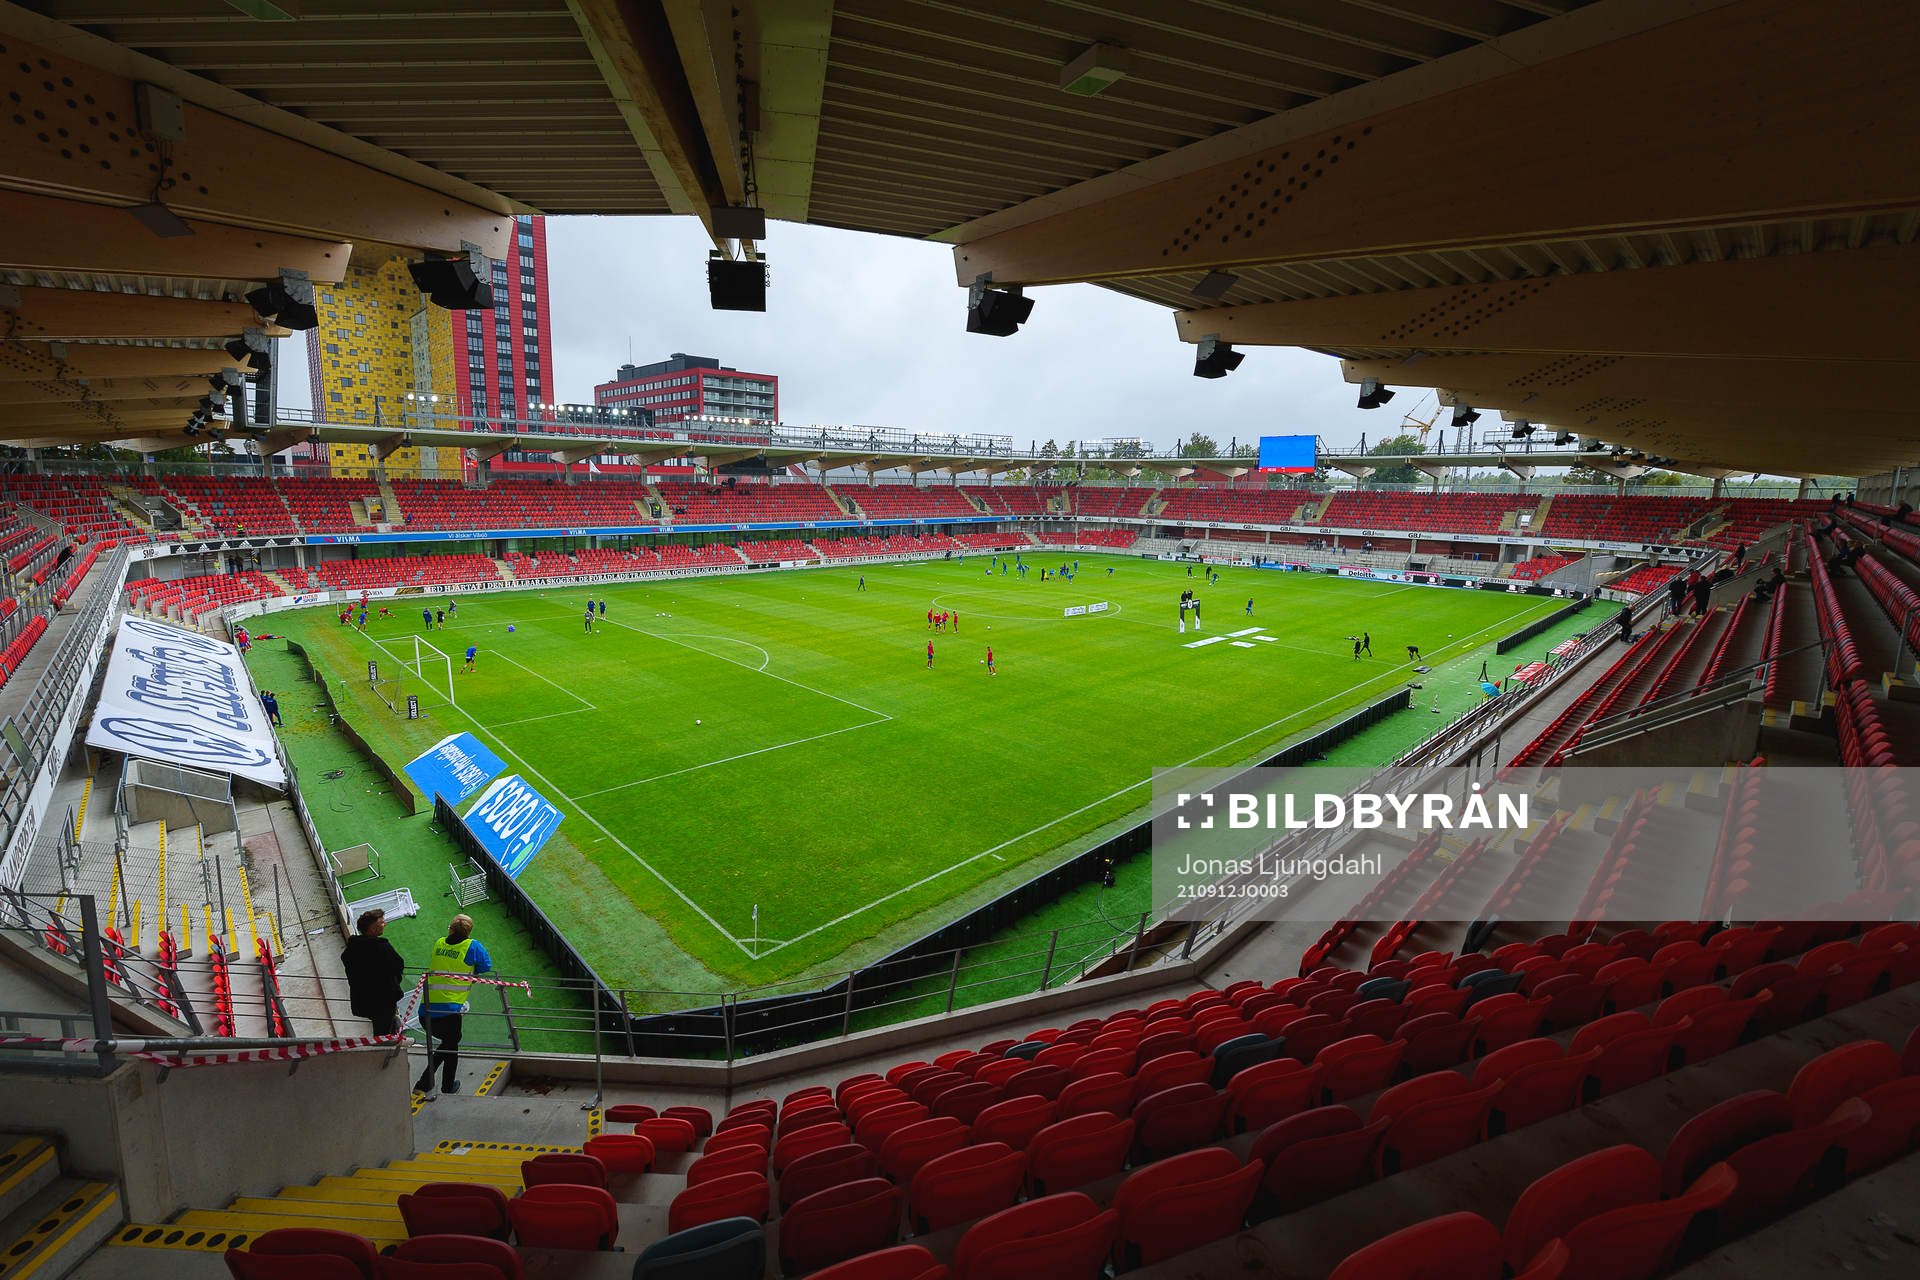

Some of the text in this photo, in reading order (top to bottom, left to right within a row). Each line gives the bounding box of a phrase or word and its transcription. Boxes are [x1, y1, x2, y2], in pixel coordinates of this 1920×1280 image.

[423, 585, 443, 593] MED
[487, 581, 504, 589] DEN
[478, 780, 539, 839] OBOS
